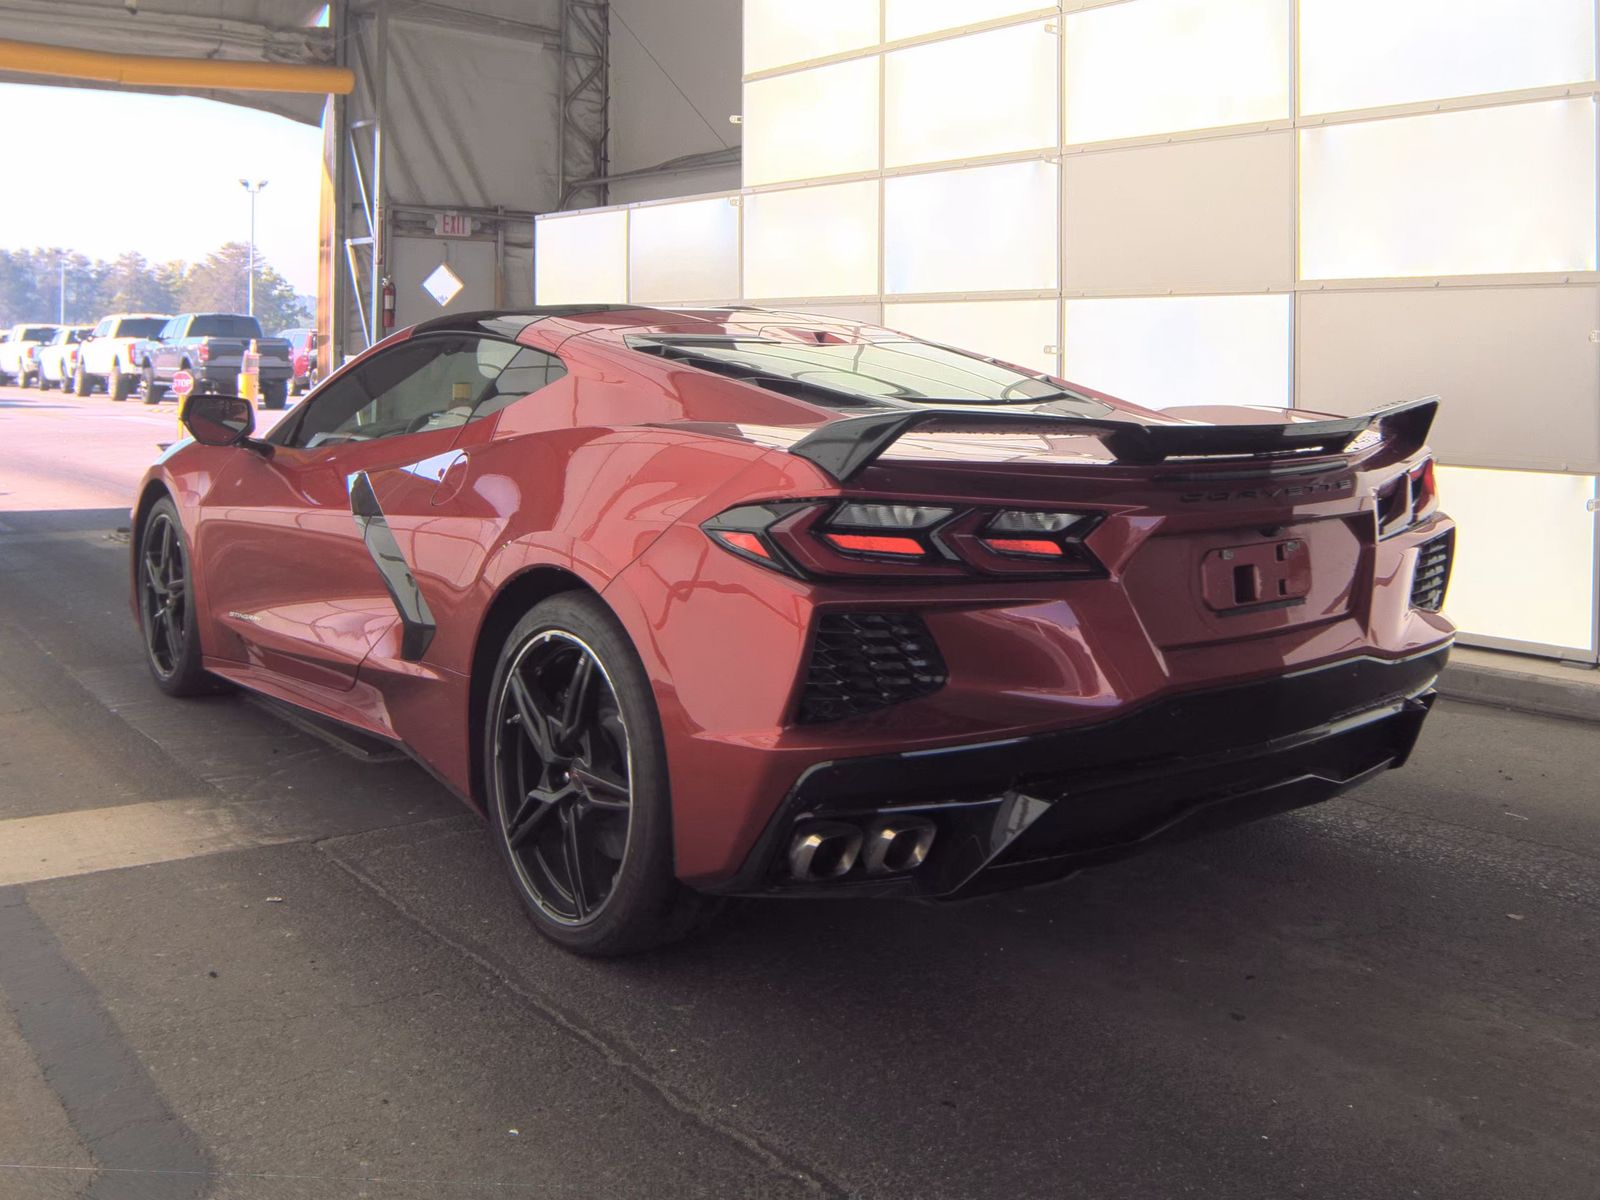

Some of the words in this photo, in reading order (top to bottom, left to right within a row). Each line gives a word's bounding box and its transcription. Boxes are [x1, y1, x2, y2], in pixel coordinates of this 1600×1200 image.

[443, 214, 466, 234] EXIT
[173, 379, 191, 387] STOP
[1180, 479, 1350, 503] CORVETTE
[228, 611, 262, 621] STINGRAY
